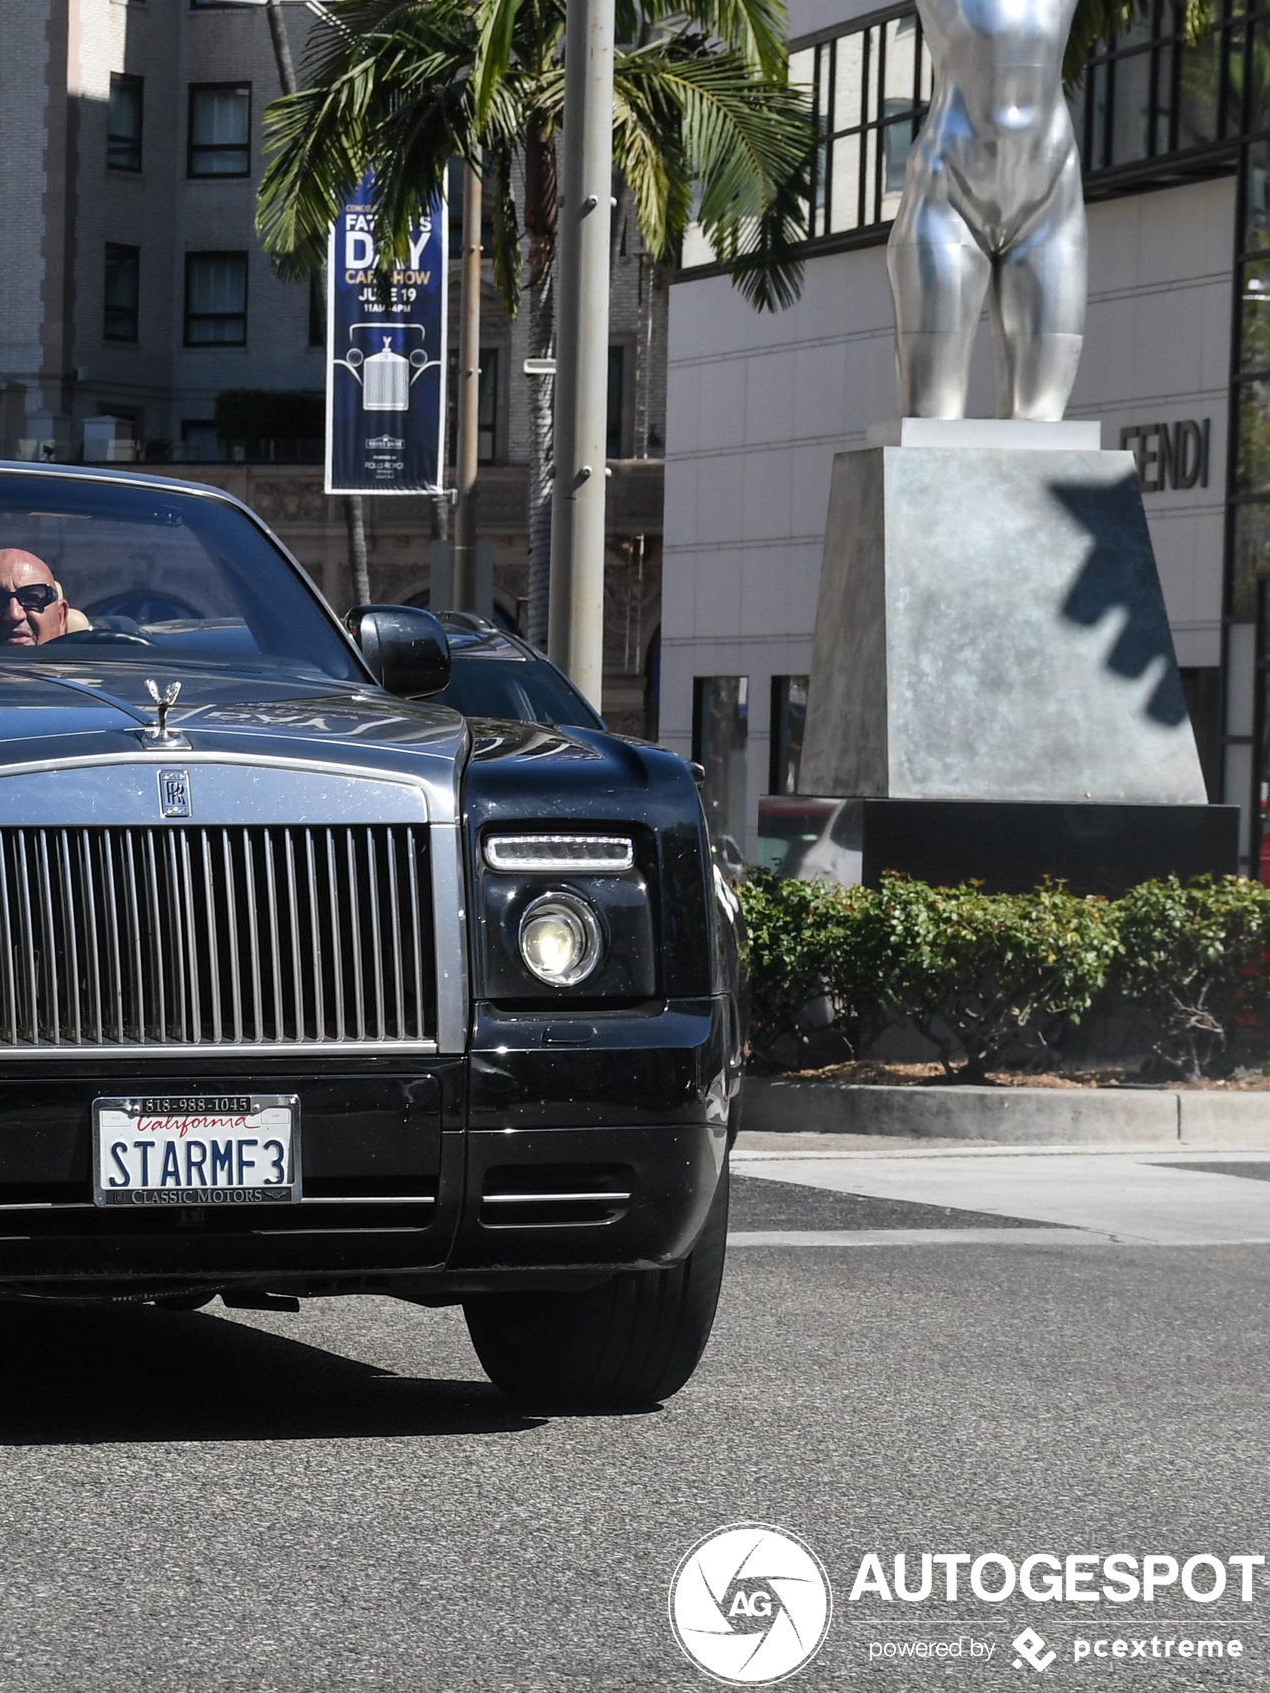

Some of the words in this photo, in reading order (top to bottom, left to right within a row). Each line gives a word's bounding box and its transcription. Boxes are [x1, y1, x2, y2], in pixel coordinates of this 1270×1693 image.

[345, 231, 431, 270] DY
[391, 270, 431, 285] HOW
[358, 287, 398, 302] JUE
[401, 288, 417, 302] 19
[146, 1098, 248, 1112] 818-988-1045
[137, 1115, 261, 1138] California
[109, 1139, 285, 1187] STARMF3
[131, 1189, 193, 1204] CLASSIC
[196, 1188, 262, 1203] MOTORS
